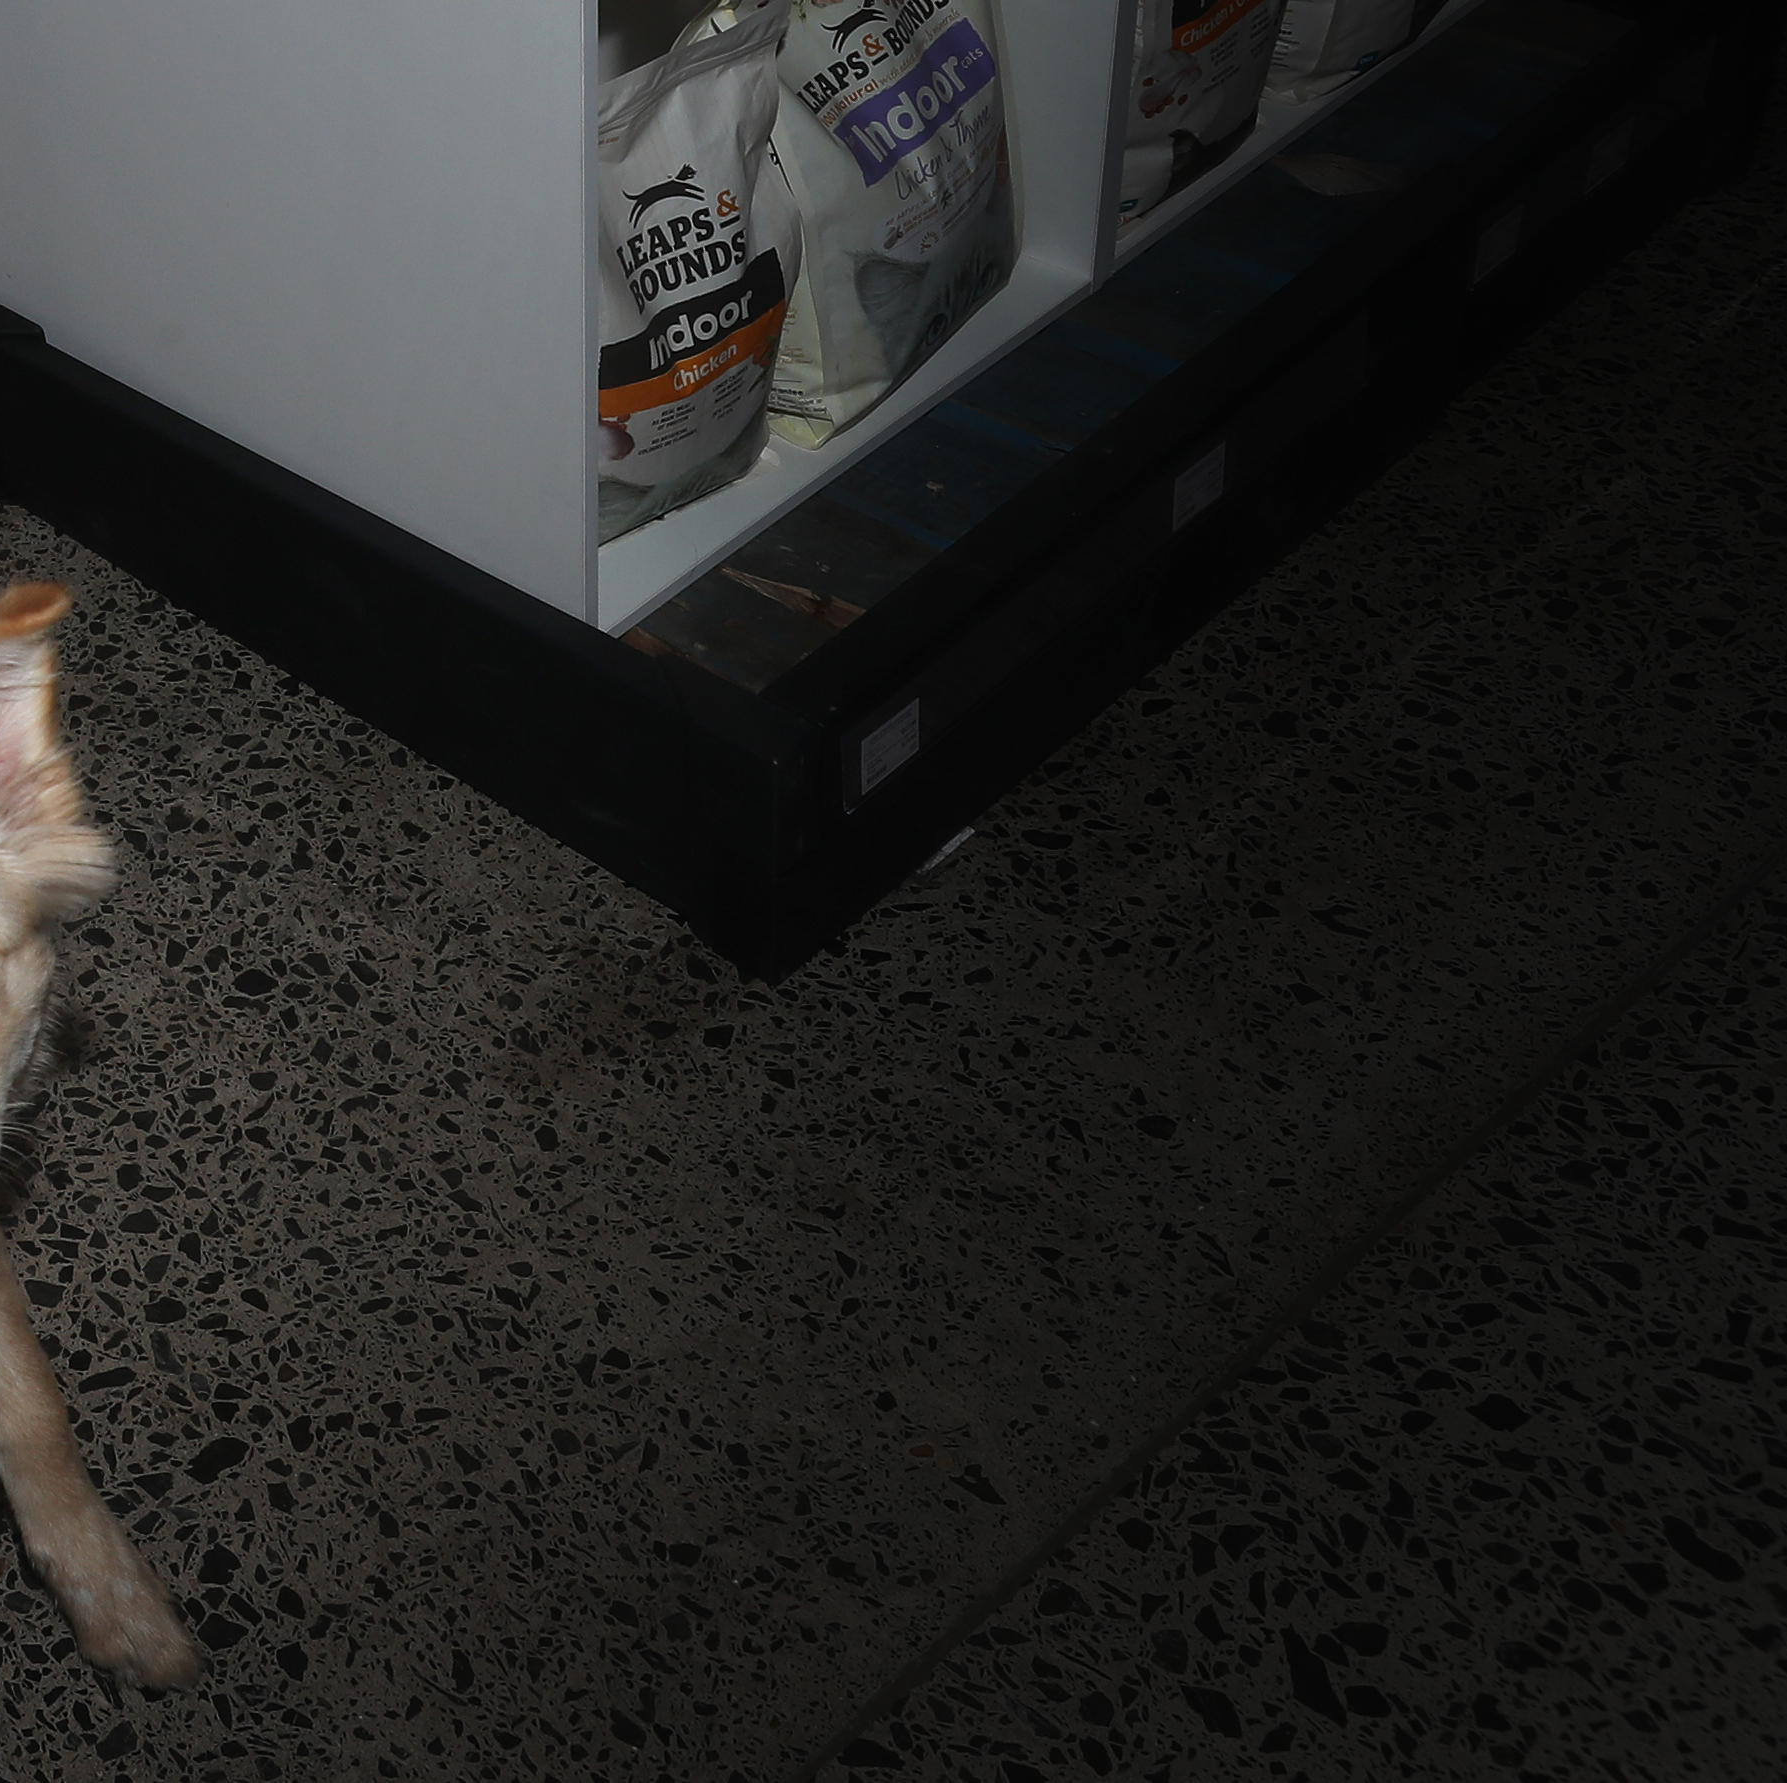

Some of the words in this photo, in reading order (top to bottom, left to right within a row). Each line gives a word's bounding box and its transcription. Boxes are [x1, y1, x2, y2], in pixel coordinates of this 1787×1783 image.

[1180, 5, 1228, 47] Chicken
[797, 51, 870, 114] LEAPS
[862, 34, 884, 58] &
[851, 55, 966, 163] Indoor
[961, 46, 984, 69] cats
[895, 140, 943, 200] Chicken
[950, 106, 993, 147] Thyme
[616, 206, 715, 280] LEAPS
[716, 189, 740, 217] &
[628, 229, 747, 315] BOUNDS
[649, 290, 753, 371] Indoor
[673, 343, 738, 391] Chicken
